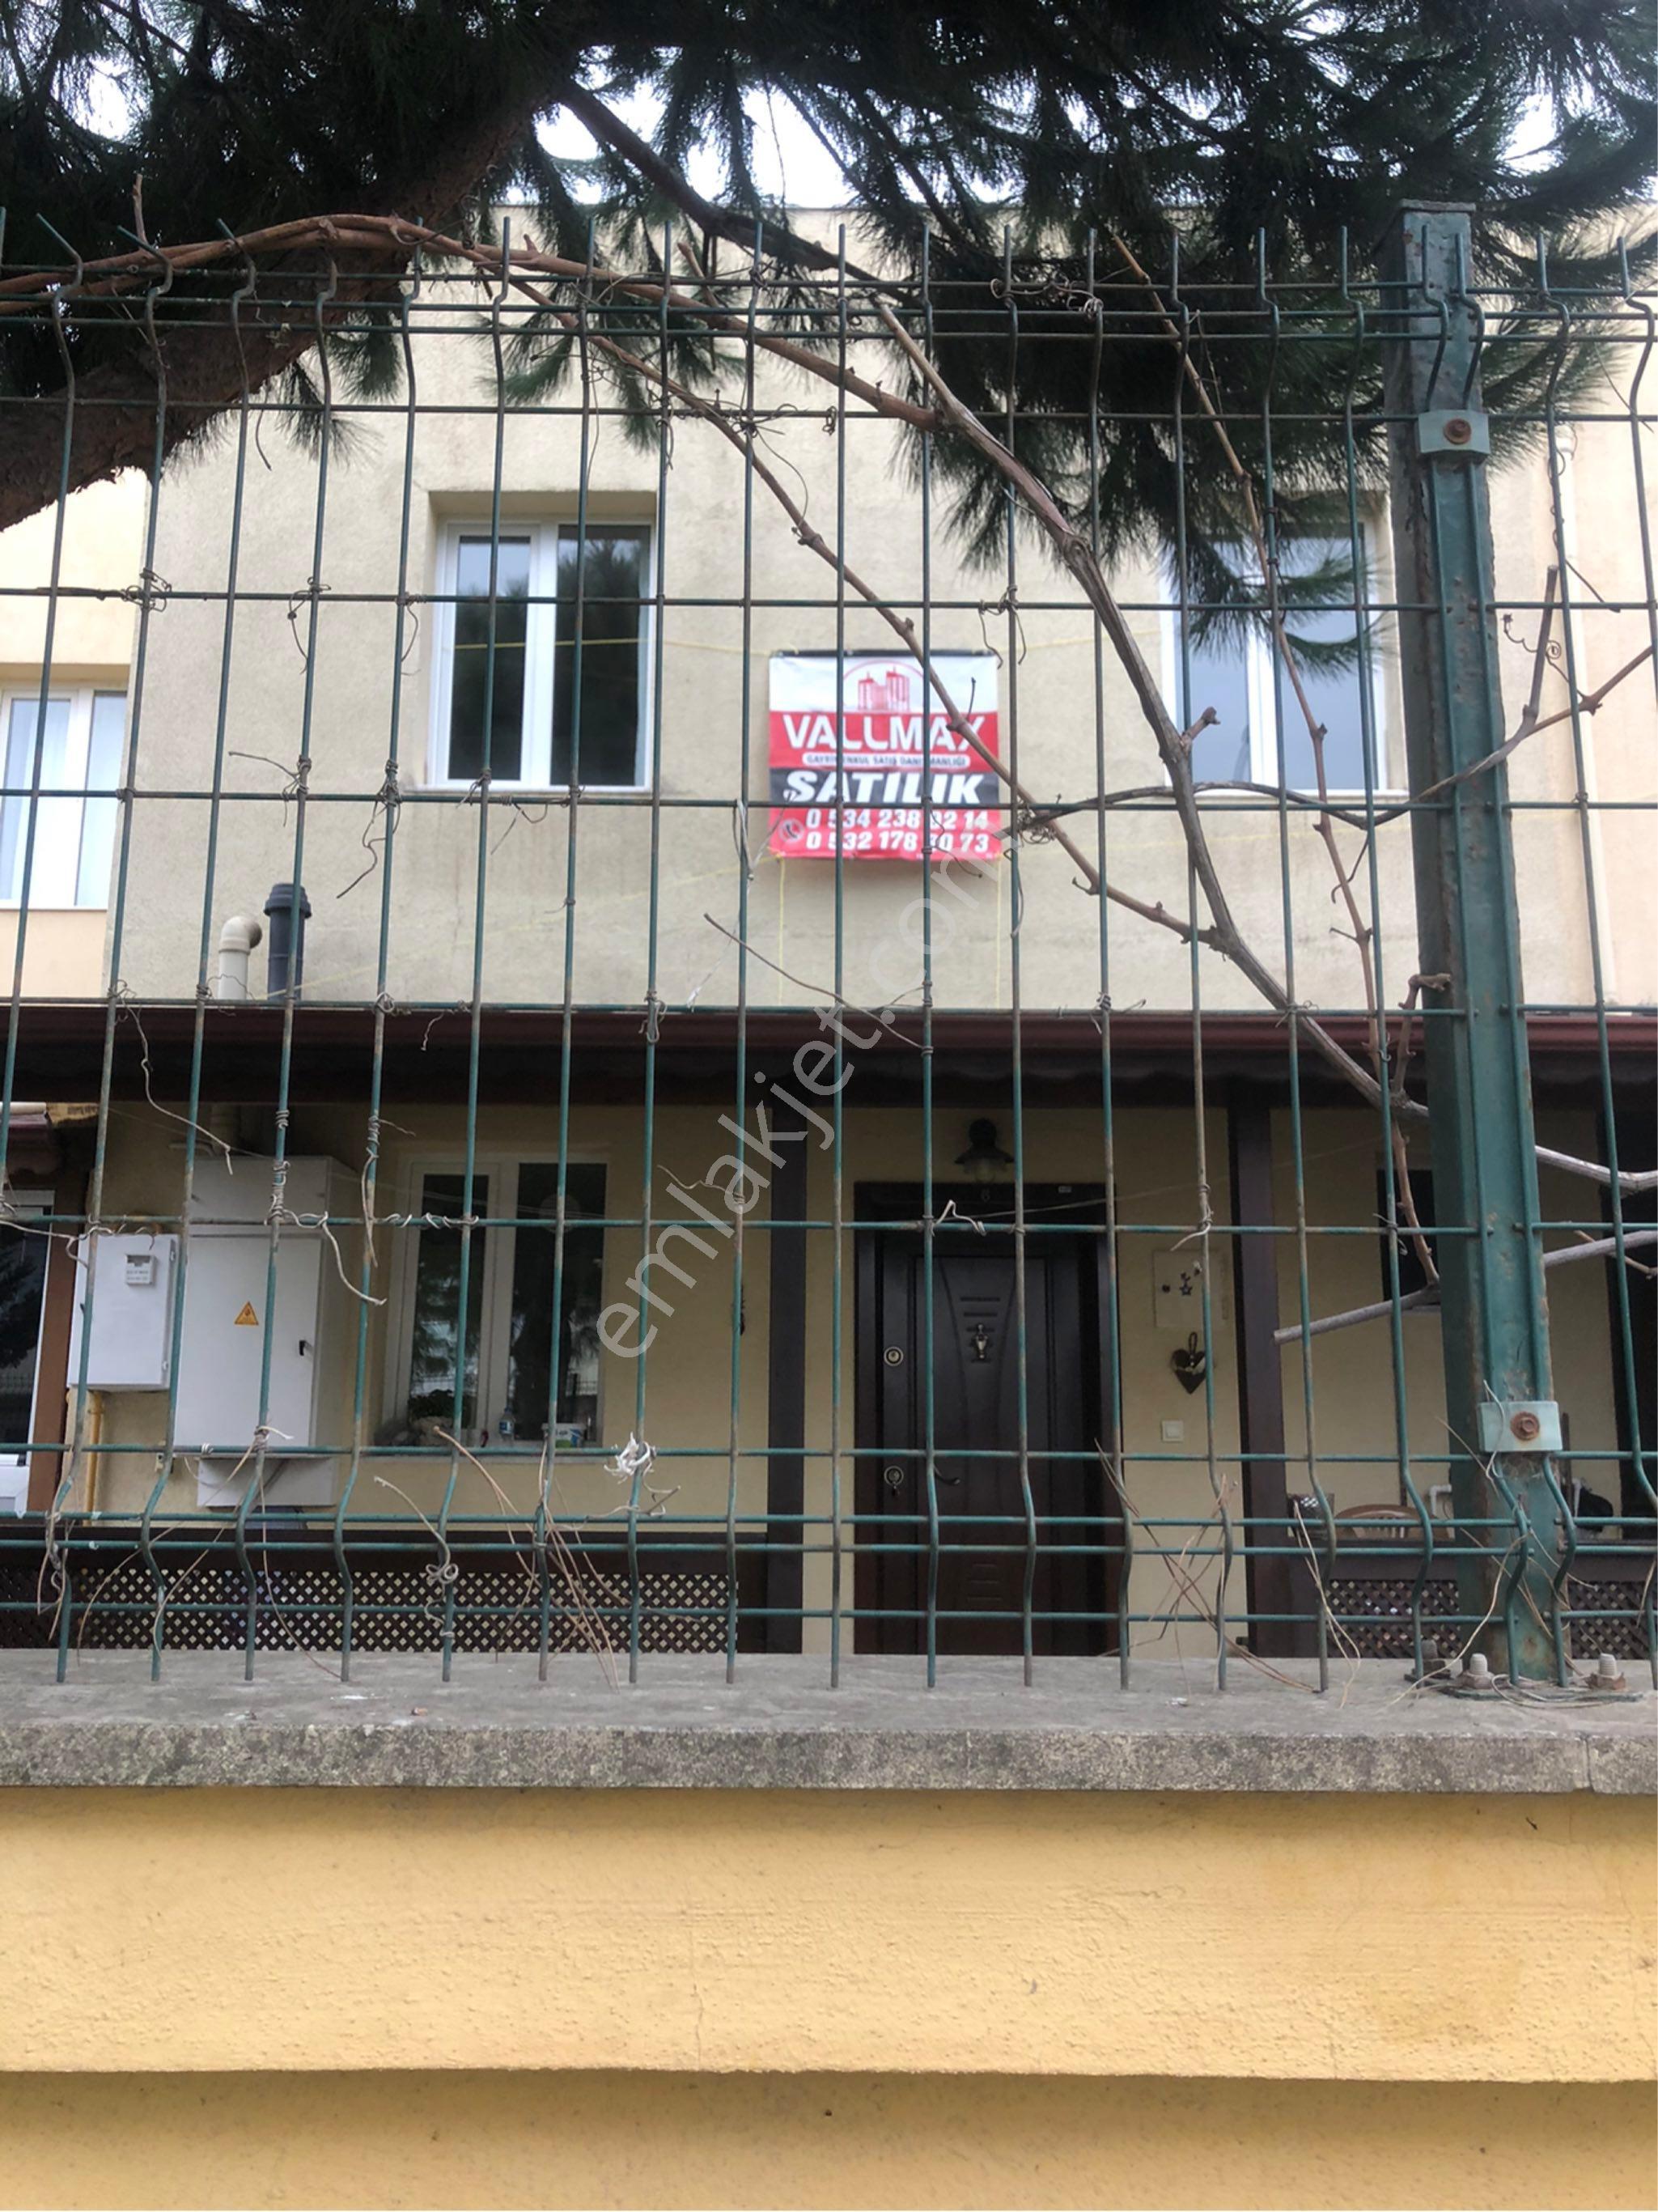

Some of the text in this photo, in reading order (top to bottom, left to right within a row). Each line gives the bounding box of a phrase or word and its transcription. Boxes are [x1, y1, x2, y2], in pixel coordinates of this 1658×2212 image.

[782, 770, 984, 804] SATILIK
[806, 808, 821, 829] 0
[876, 809, 921, 830] 238
[964, 810, 989, 831] 14
[806, 831, 822, 850] 0
[879, 831, 918, 852] 178
[960, 832, 990, 852] 73
